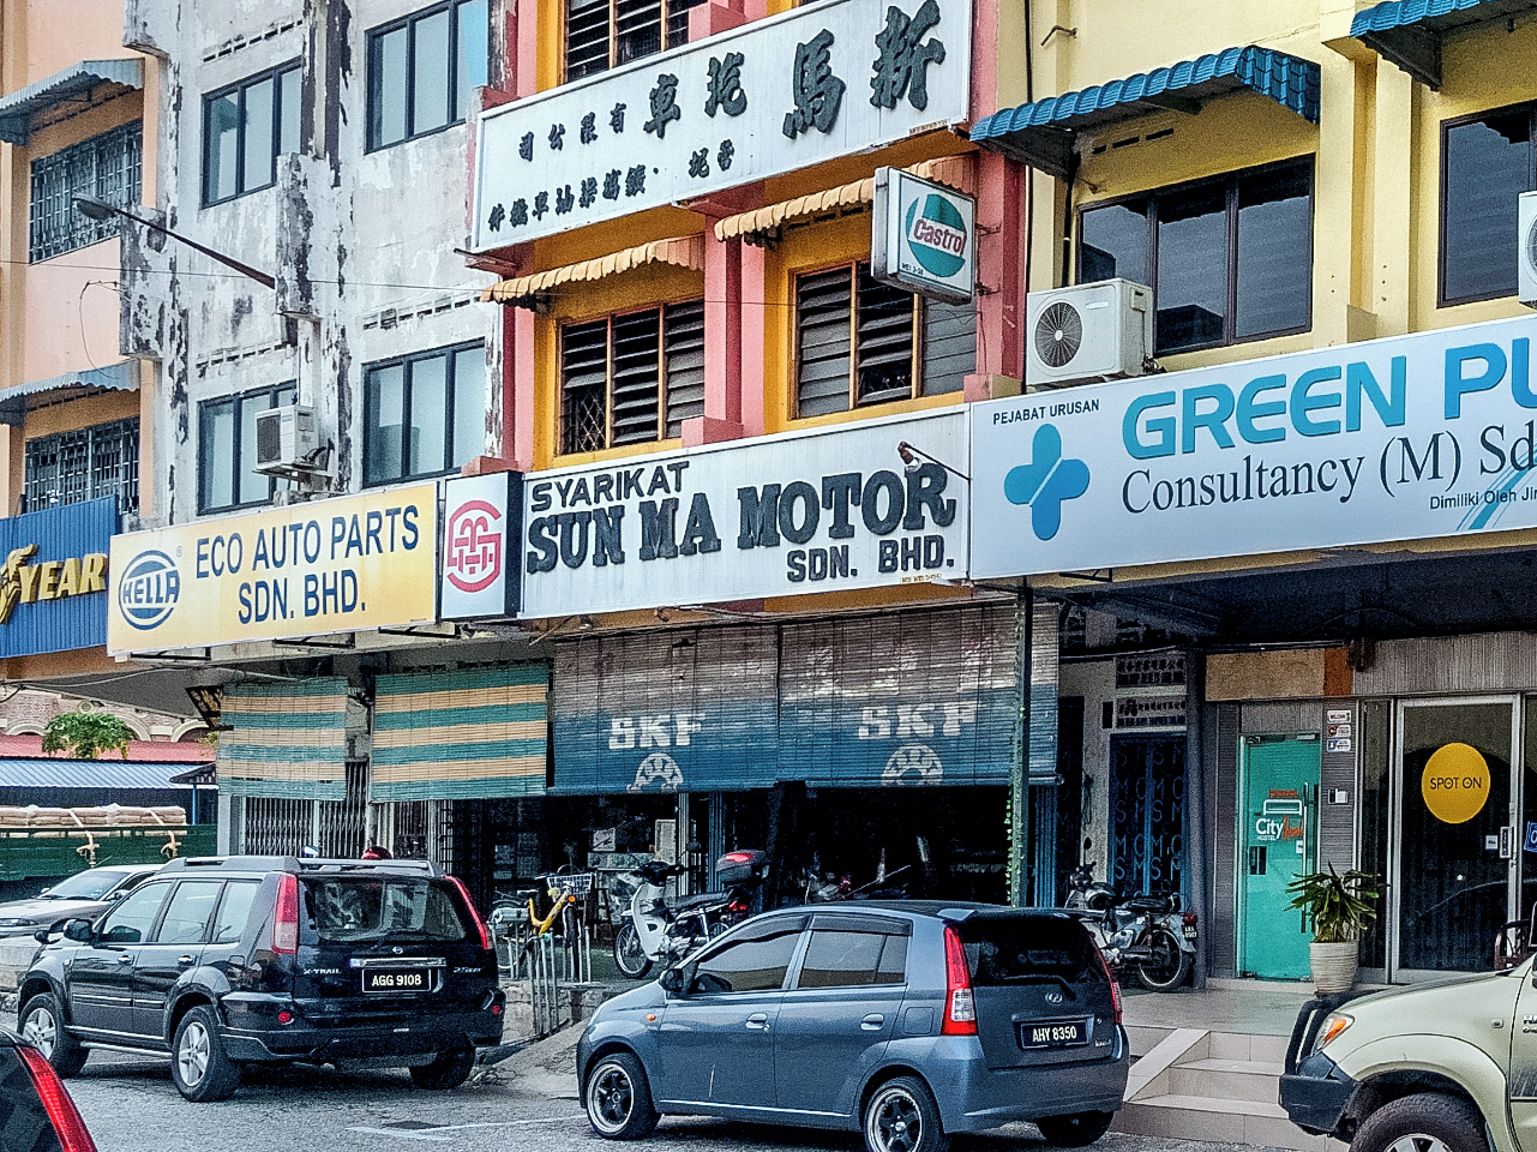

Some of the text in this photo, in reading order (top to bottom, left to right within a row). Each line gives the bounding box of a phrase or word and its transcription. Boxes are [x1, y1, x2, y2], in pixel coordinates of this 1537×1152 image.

[914, 218, 967, 255] Castrol
[993, 398, 1100, 426] PEJABAT URUSAN
[1122, 355, 1406, 461] GREEN
[531, 460, 690, 513] SYARIKAT
[1122, 454, 1366, 514] Consultancy
[1380, 429, 1462, 498] (M)
[1429, 490, 1479, 510] Dimiliki
[1483, 488, 1517, 505] Oleh
[526, 462, 957, 575] SUN MA MOTOR
[196, 504, 419, 579] ECO AUTO PARTS
[786, 535, 955, 583] SDN. BHD.
[18, 553, 108, 604] YEAR
[123, 569, 181, 605] HELLA
[238, 569, 366, 625] SDN. BHD.
[608, 713, 706, 750] SKF
[858, 700, 979, 740] SKF
[1429, 775, 1483, 791] SPOT ON
[1255, 817, 1284, 840] City
[371, 973, 422, 987] AGG 9108
[1032, 1025, 1077, 1043] AHY 8350
